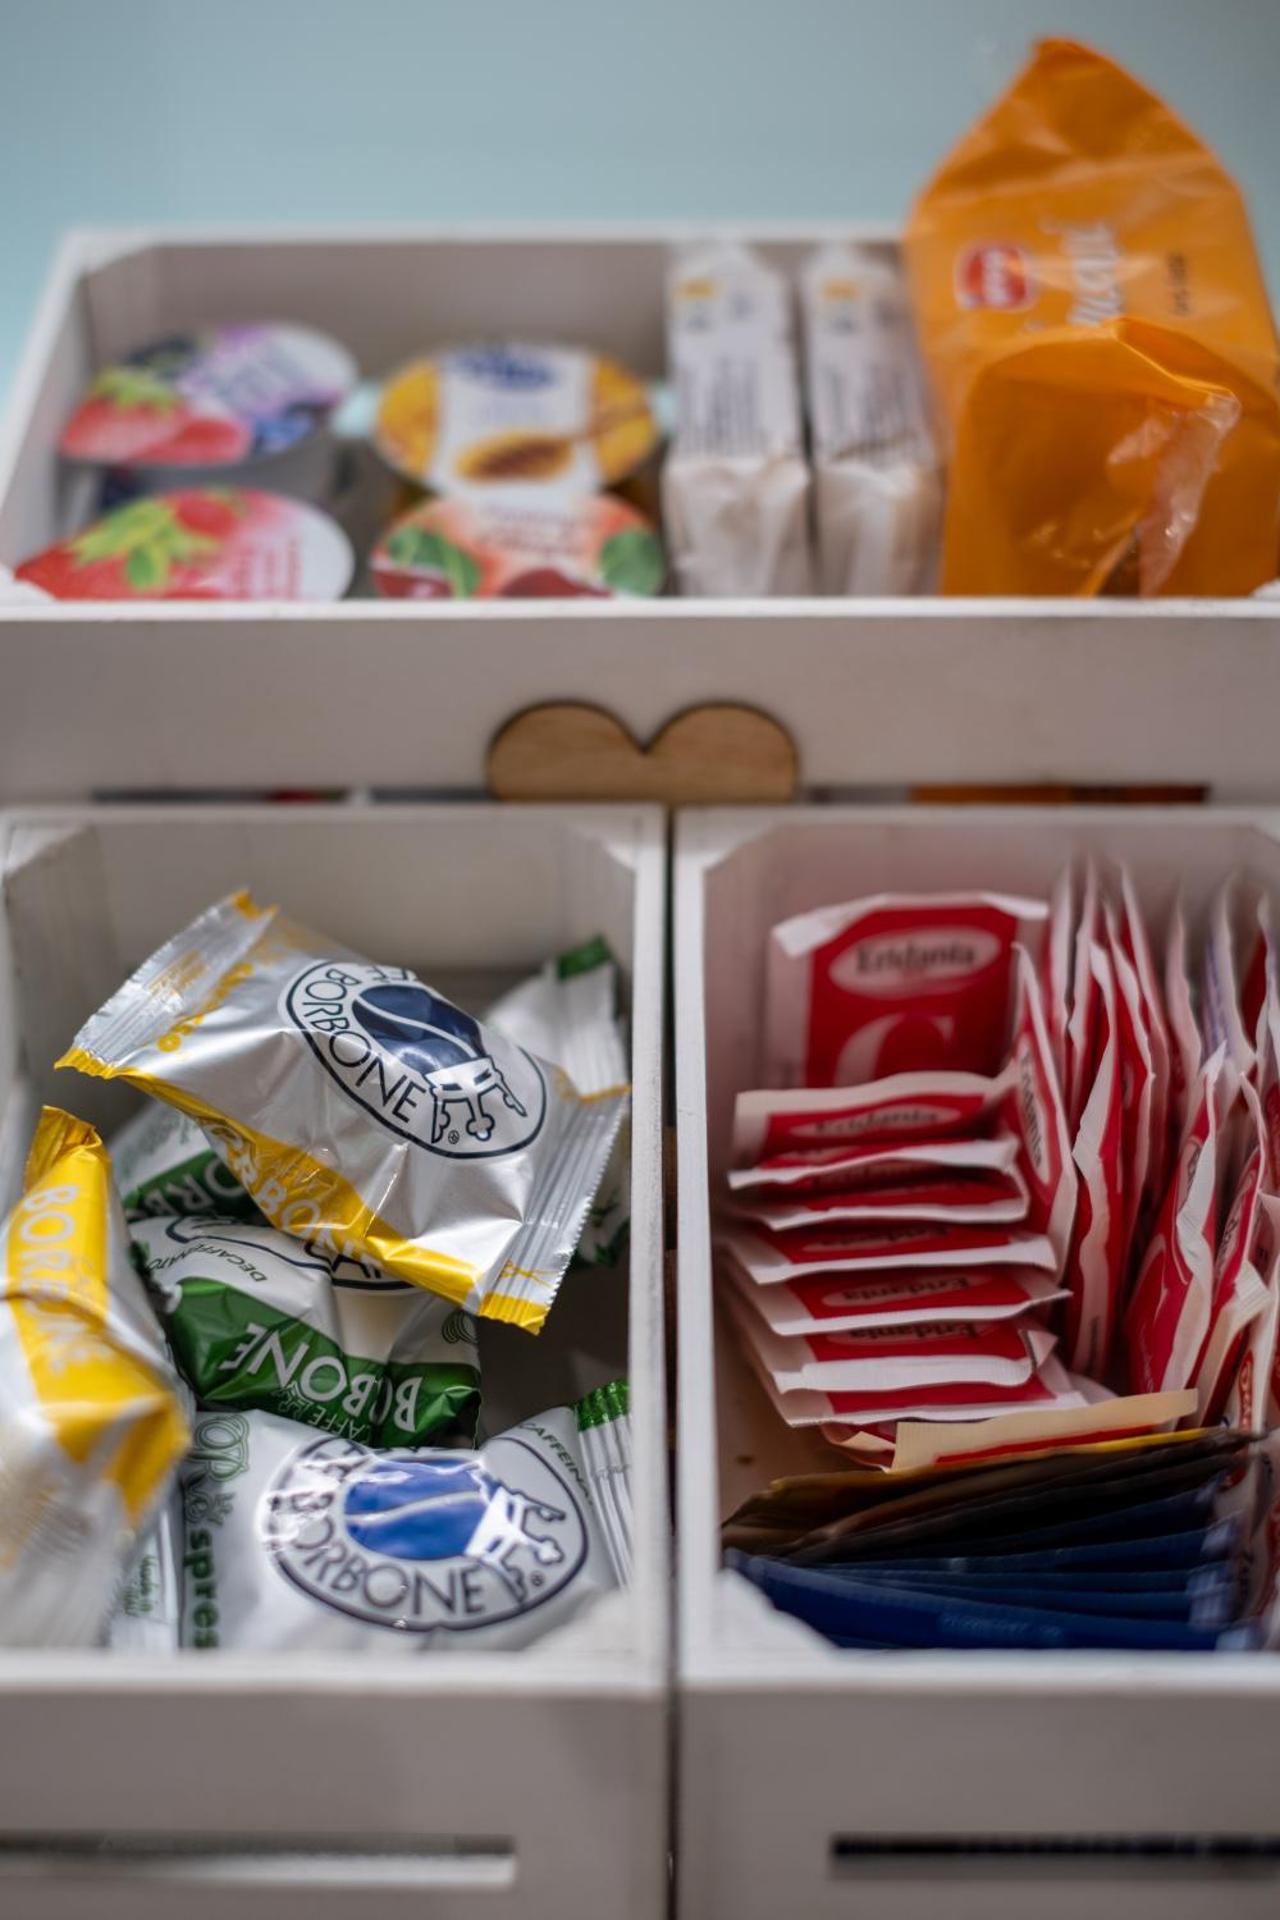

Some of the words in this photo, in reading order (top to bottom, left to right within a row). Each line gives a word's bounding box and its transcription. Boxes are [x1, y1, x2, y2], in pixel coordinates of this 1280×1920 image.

[855, 943, 976, 976] Eridania
[301, 967, 427, 1124] BORBONE
[218, 1322, 423, 1433] BOBONE
